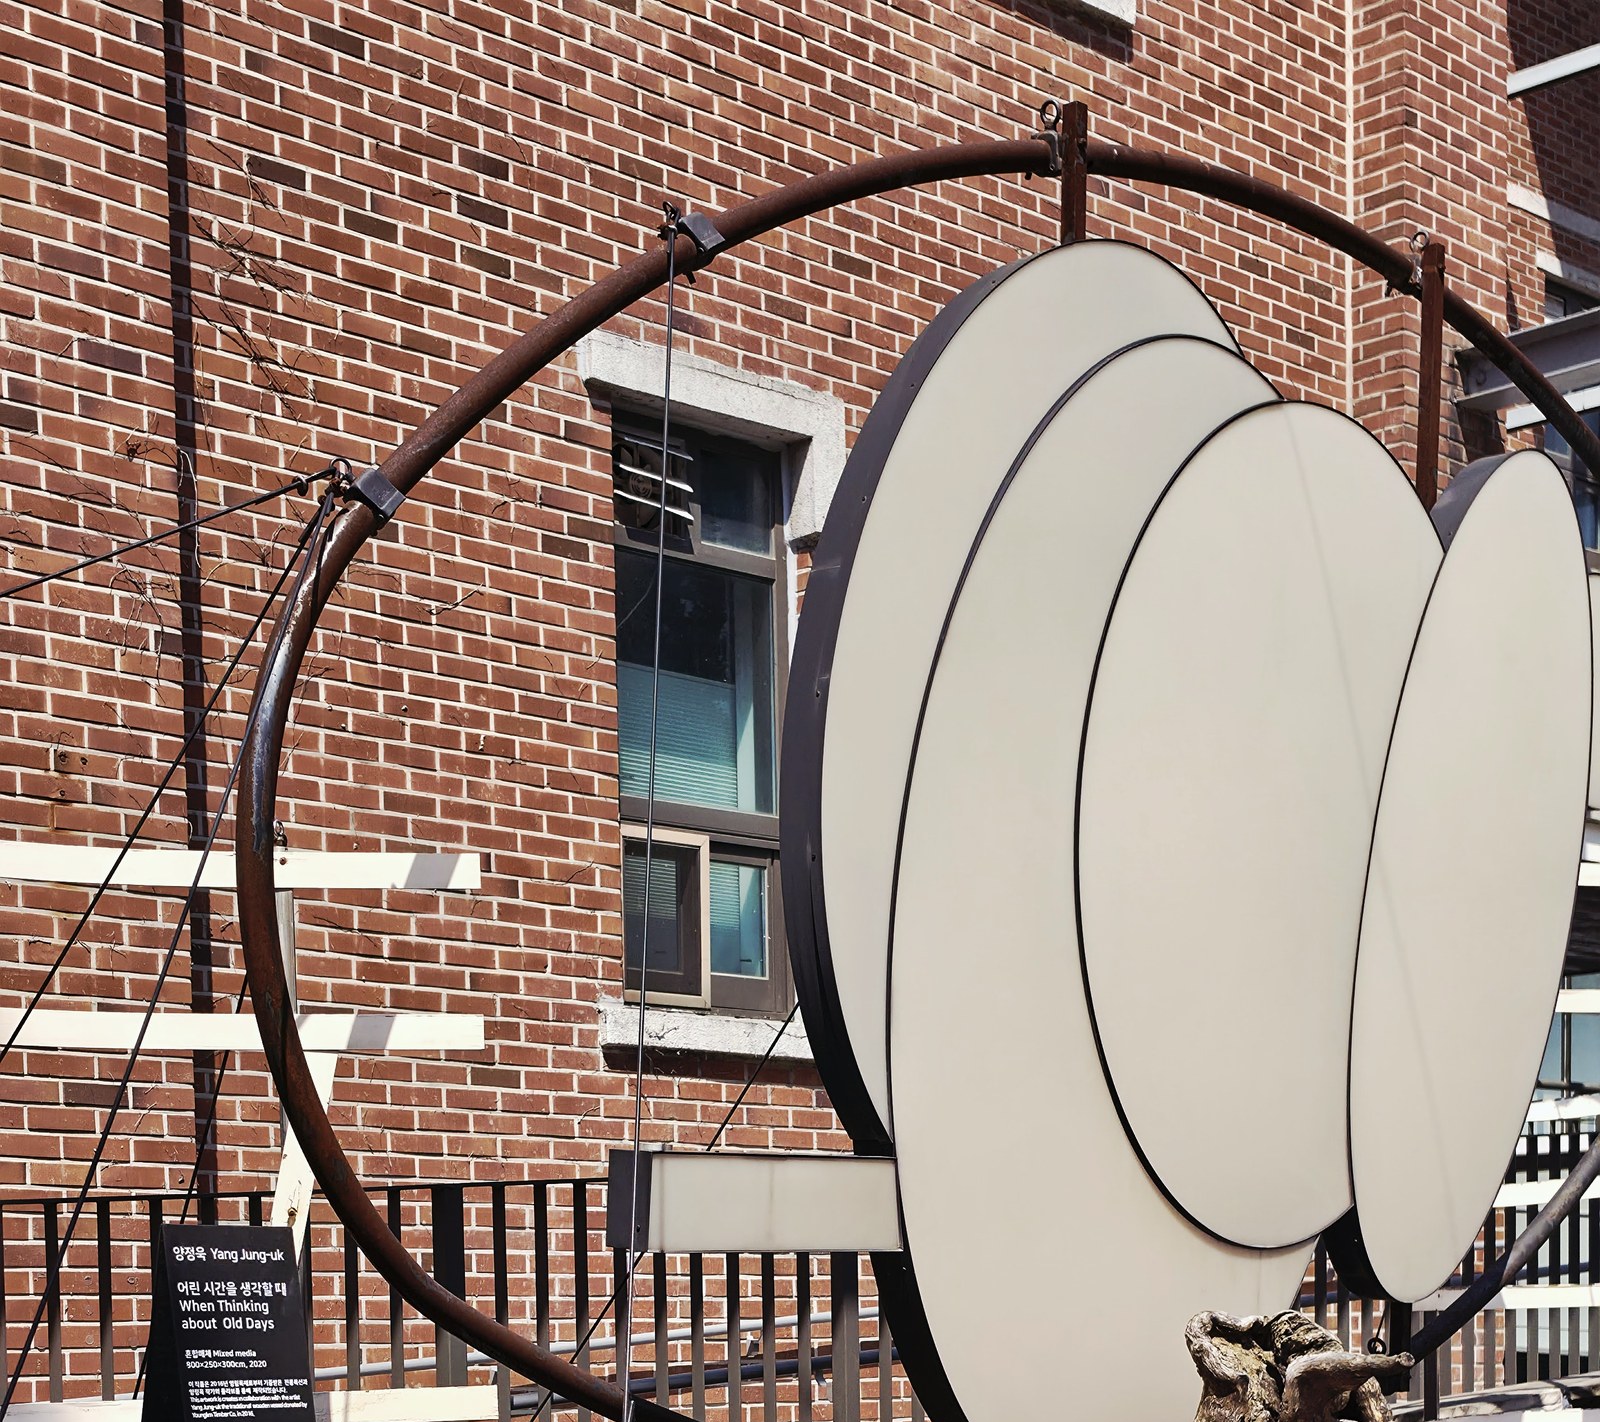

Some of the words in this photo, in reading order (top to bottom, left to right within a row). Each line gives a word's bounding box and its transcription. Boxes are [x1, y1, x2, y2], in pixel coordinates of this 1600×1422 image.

[173, 1246, 207, 1261] 양정욱
[210, 1247, 239, 1263] Yang
[240, 1248, 285, 1263] Jung-uk
[177, 1281, 201, 1296] 어린
[203, 1281, 238, 1296] 시간을
[240, 1281, 274, 1297] 생각할
[274, 1282, 287, 1297] 때
[179, 1299, 216, 1312] When
[217, 1299, 270, 1315] Thinking
[181, 1316, 218, 1330] about
[222, 1316, 243, 1329] Old
[245, 1317, 275, 1332] Days
[213, 1349, 234, 1357] Mixed
[235, 1349, 257, 1357] media
[249, 1360, 267, 1368] 2020
